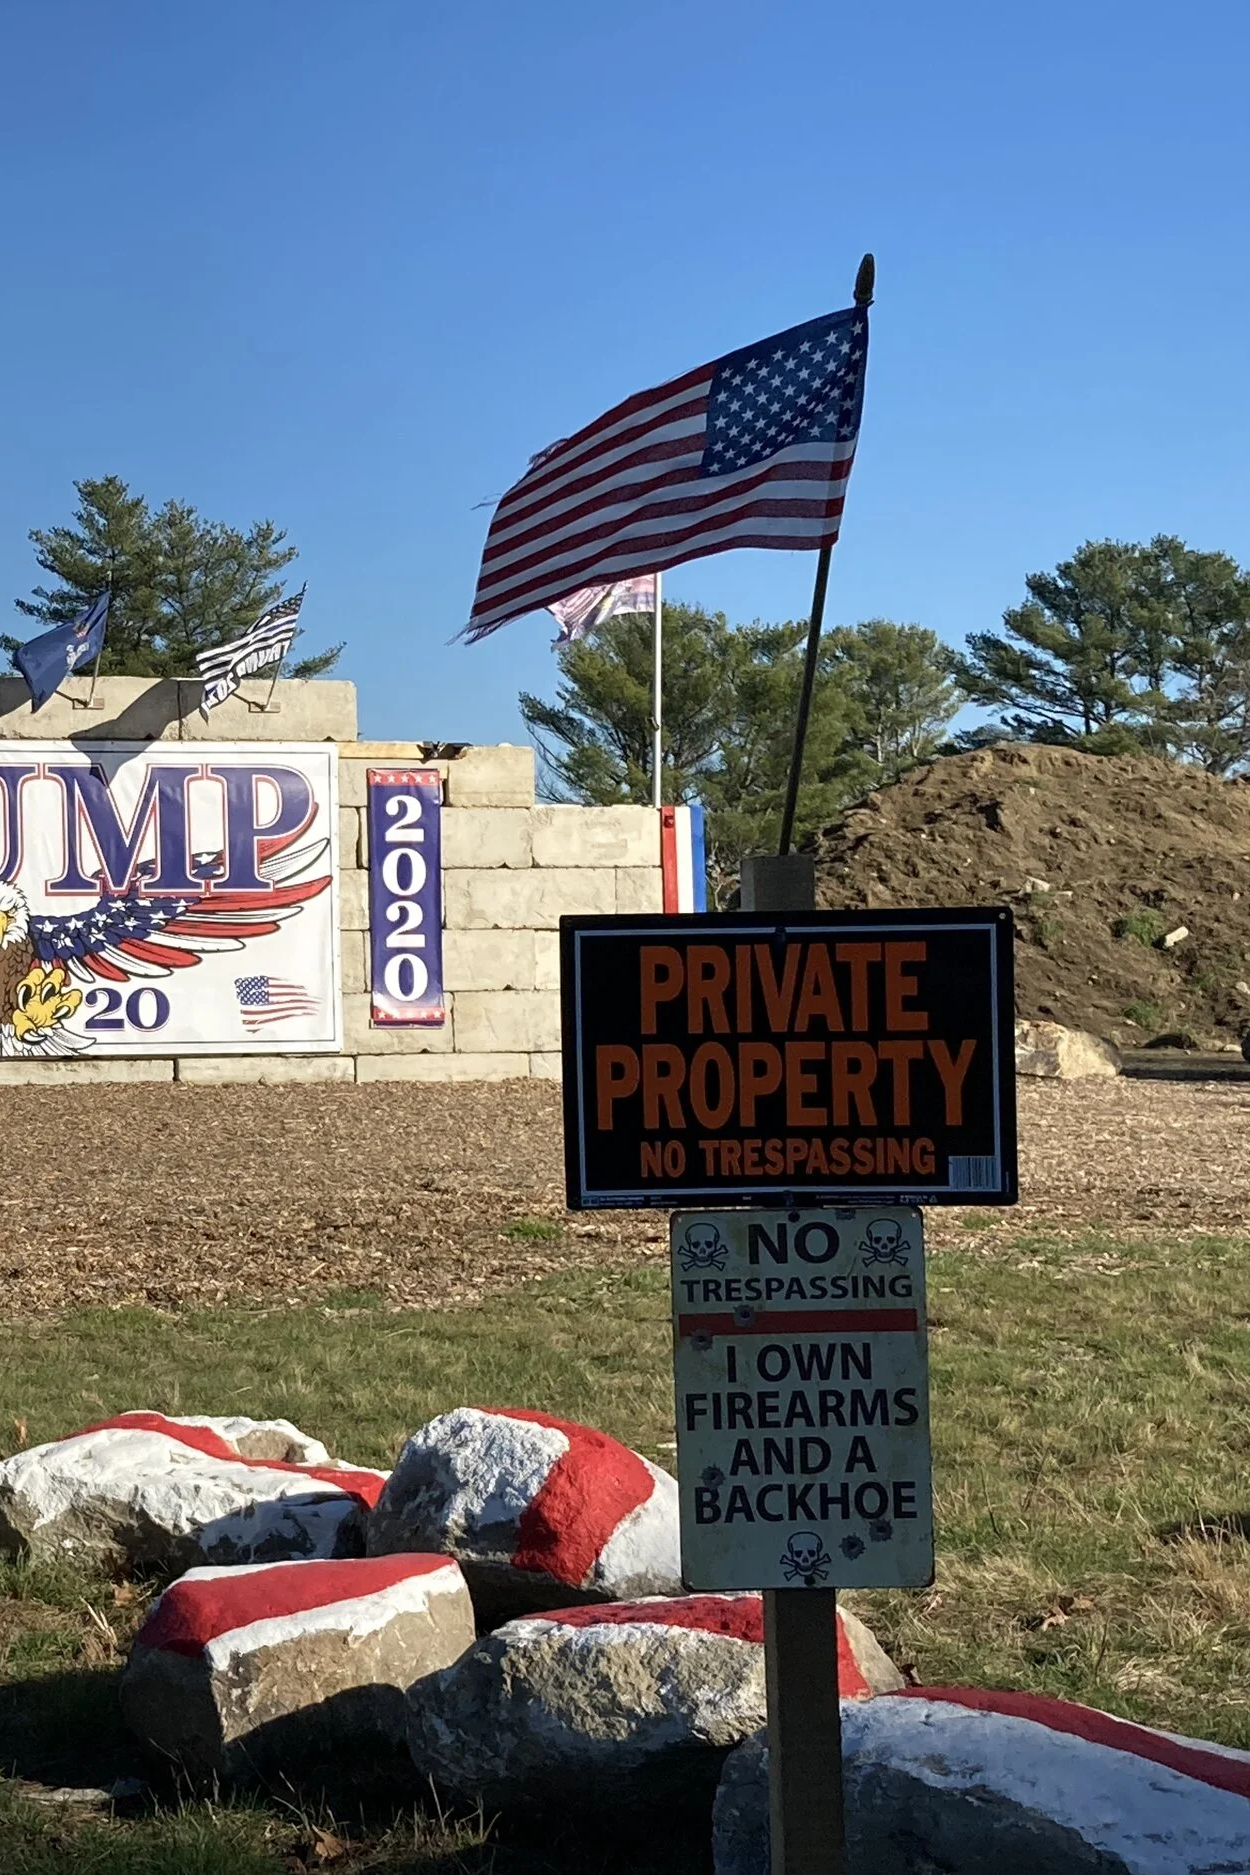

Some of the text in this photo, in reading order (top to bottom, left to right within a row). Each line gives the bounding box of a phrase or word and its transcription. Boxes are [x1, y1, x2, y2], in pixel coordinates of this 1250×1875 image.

[382, 795, 428, 1002] 2020
[84, 986, 171, 1032] 20
[639, 941, 929, 1035] PRIVATE
[596, 1039, 977, 1131] PROPERTY
[640, 1137, 936, 1178] NO TRESPASSING
[747, 1221, 840, 1265] NO
[680, 1274, 913, 1303] TRESPASSING
[726, 1342, 872, 1383] I OWN
[686, 1388, 919, 1431] FIREARMS
[729, 1435, 877, 1476] AND A
[694, 1481, 918, 1525] BACKHOE
